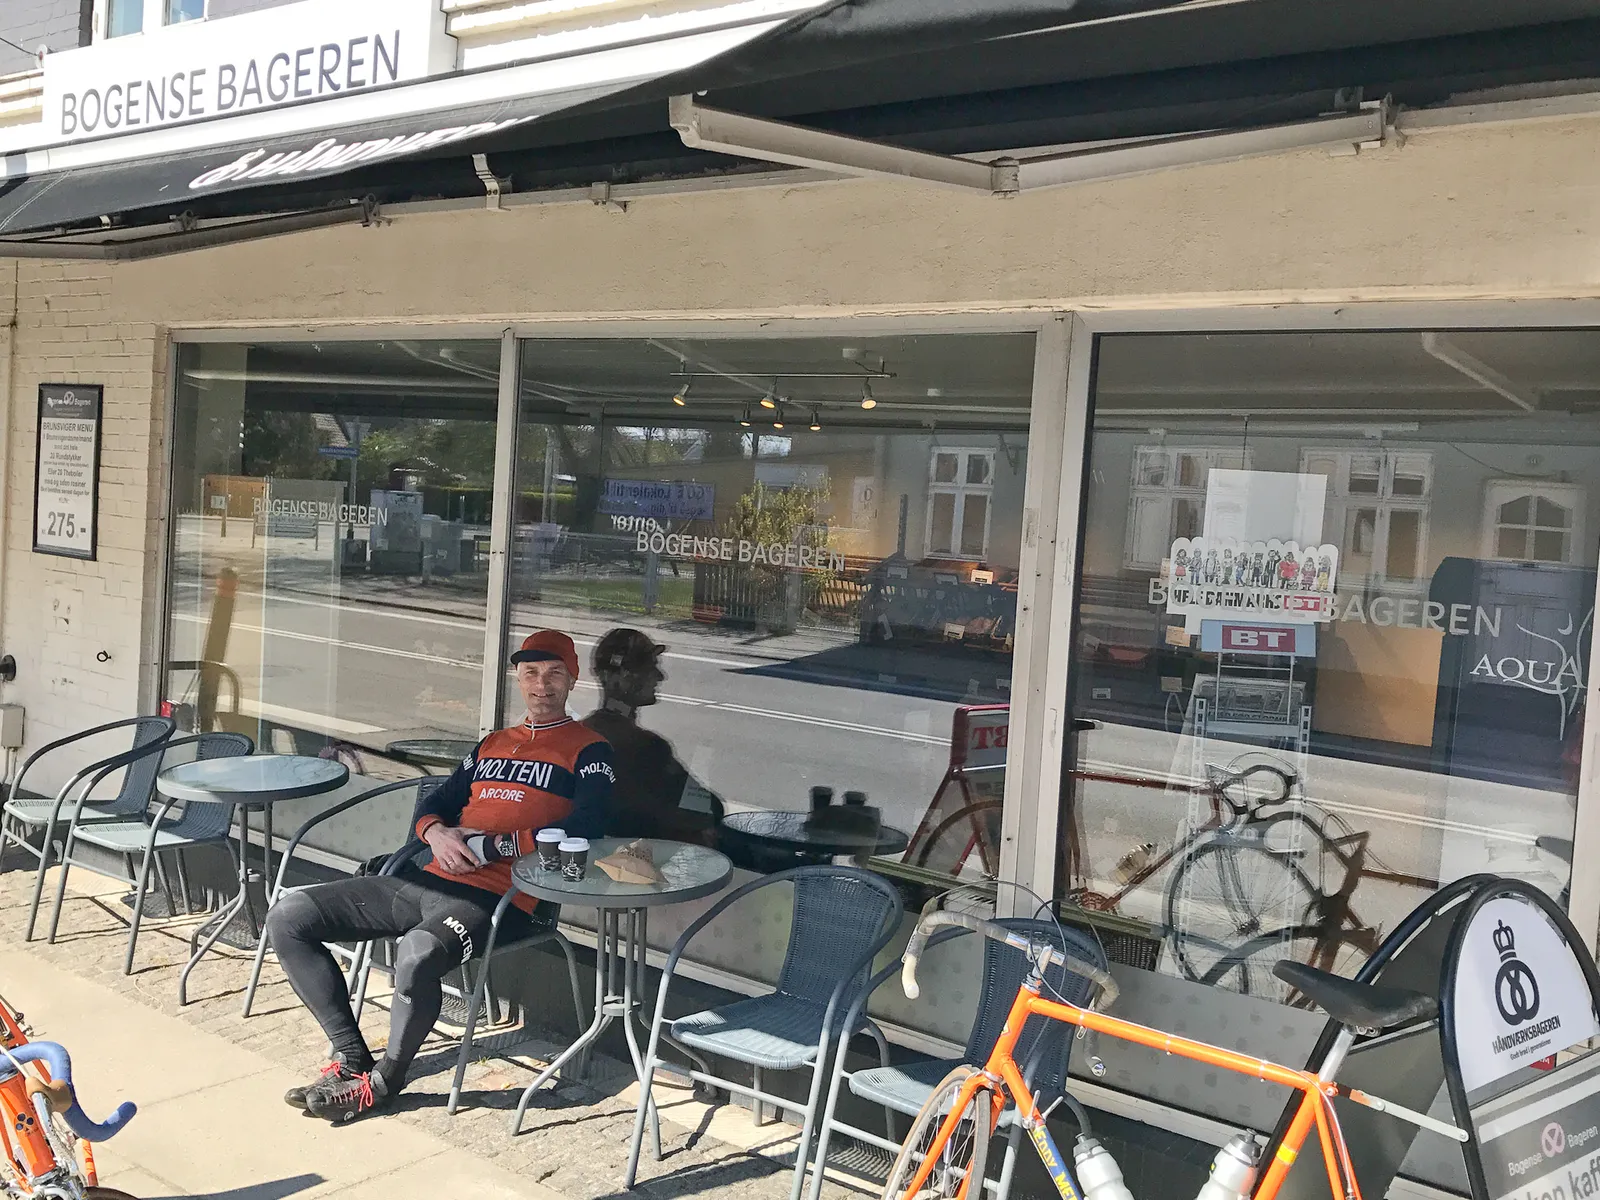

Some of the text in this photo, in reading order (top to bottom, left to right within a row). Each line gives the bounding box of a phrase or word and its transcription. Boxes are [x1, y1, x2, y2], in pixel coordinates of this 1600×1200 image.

[61, 29, 401, 135] BOGENSE BAGEREN
[77, 423, 93, 432] MENU
[253, 496, 389, 527] BOGENSE BAGEREN
[636, 531, 846, 572] BOGENSE BAGEREN
[1320, 591, 1502, 638] BAGEREN
[1231, 629, 1287, 648] BT
[1469, 653, 1588, 695] AQUA
[472, 757, 553, 789] MOLTENI
[579, 760, 616, 784] MOLTENI
[478, 787, 525, 803] ARCORE
[1491, 1015, 1561, 1055] HÅNDVÆRKSBAGEREN
[1034, 1130, 1058, 1168] EDDY
[1508, 1125, 1599, 1177] Bogense Bageren
